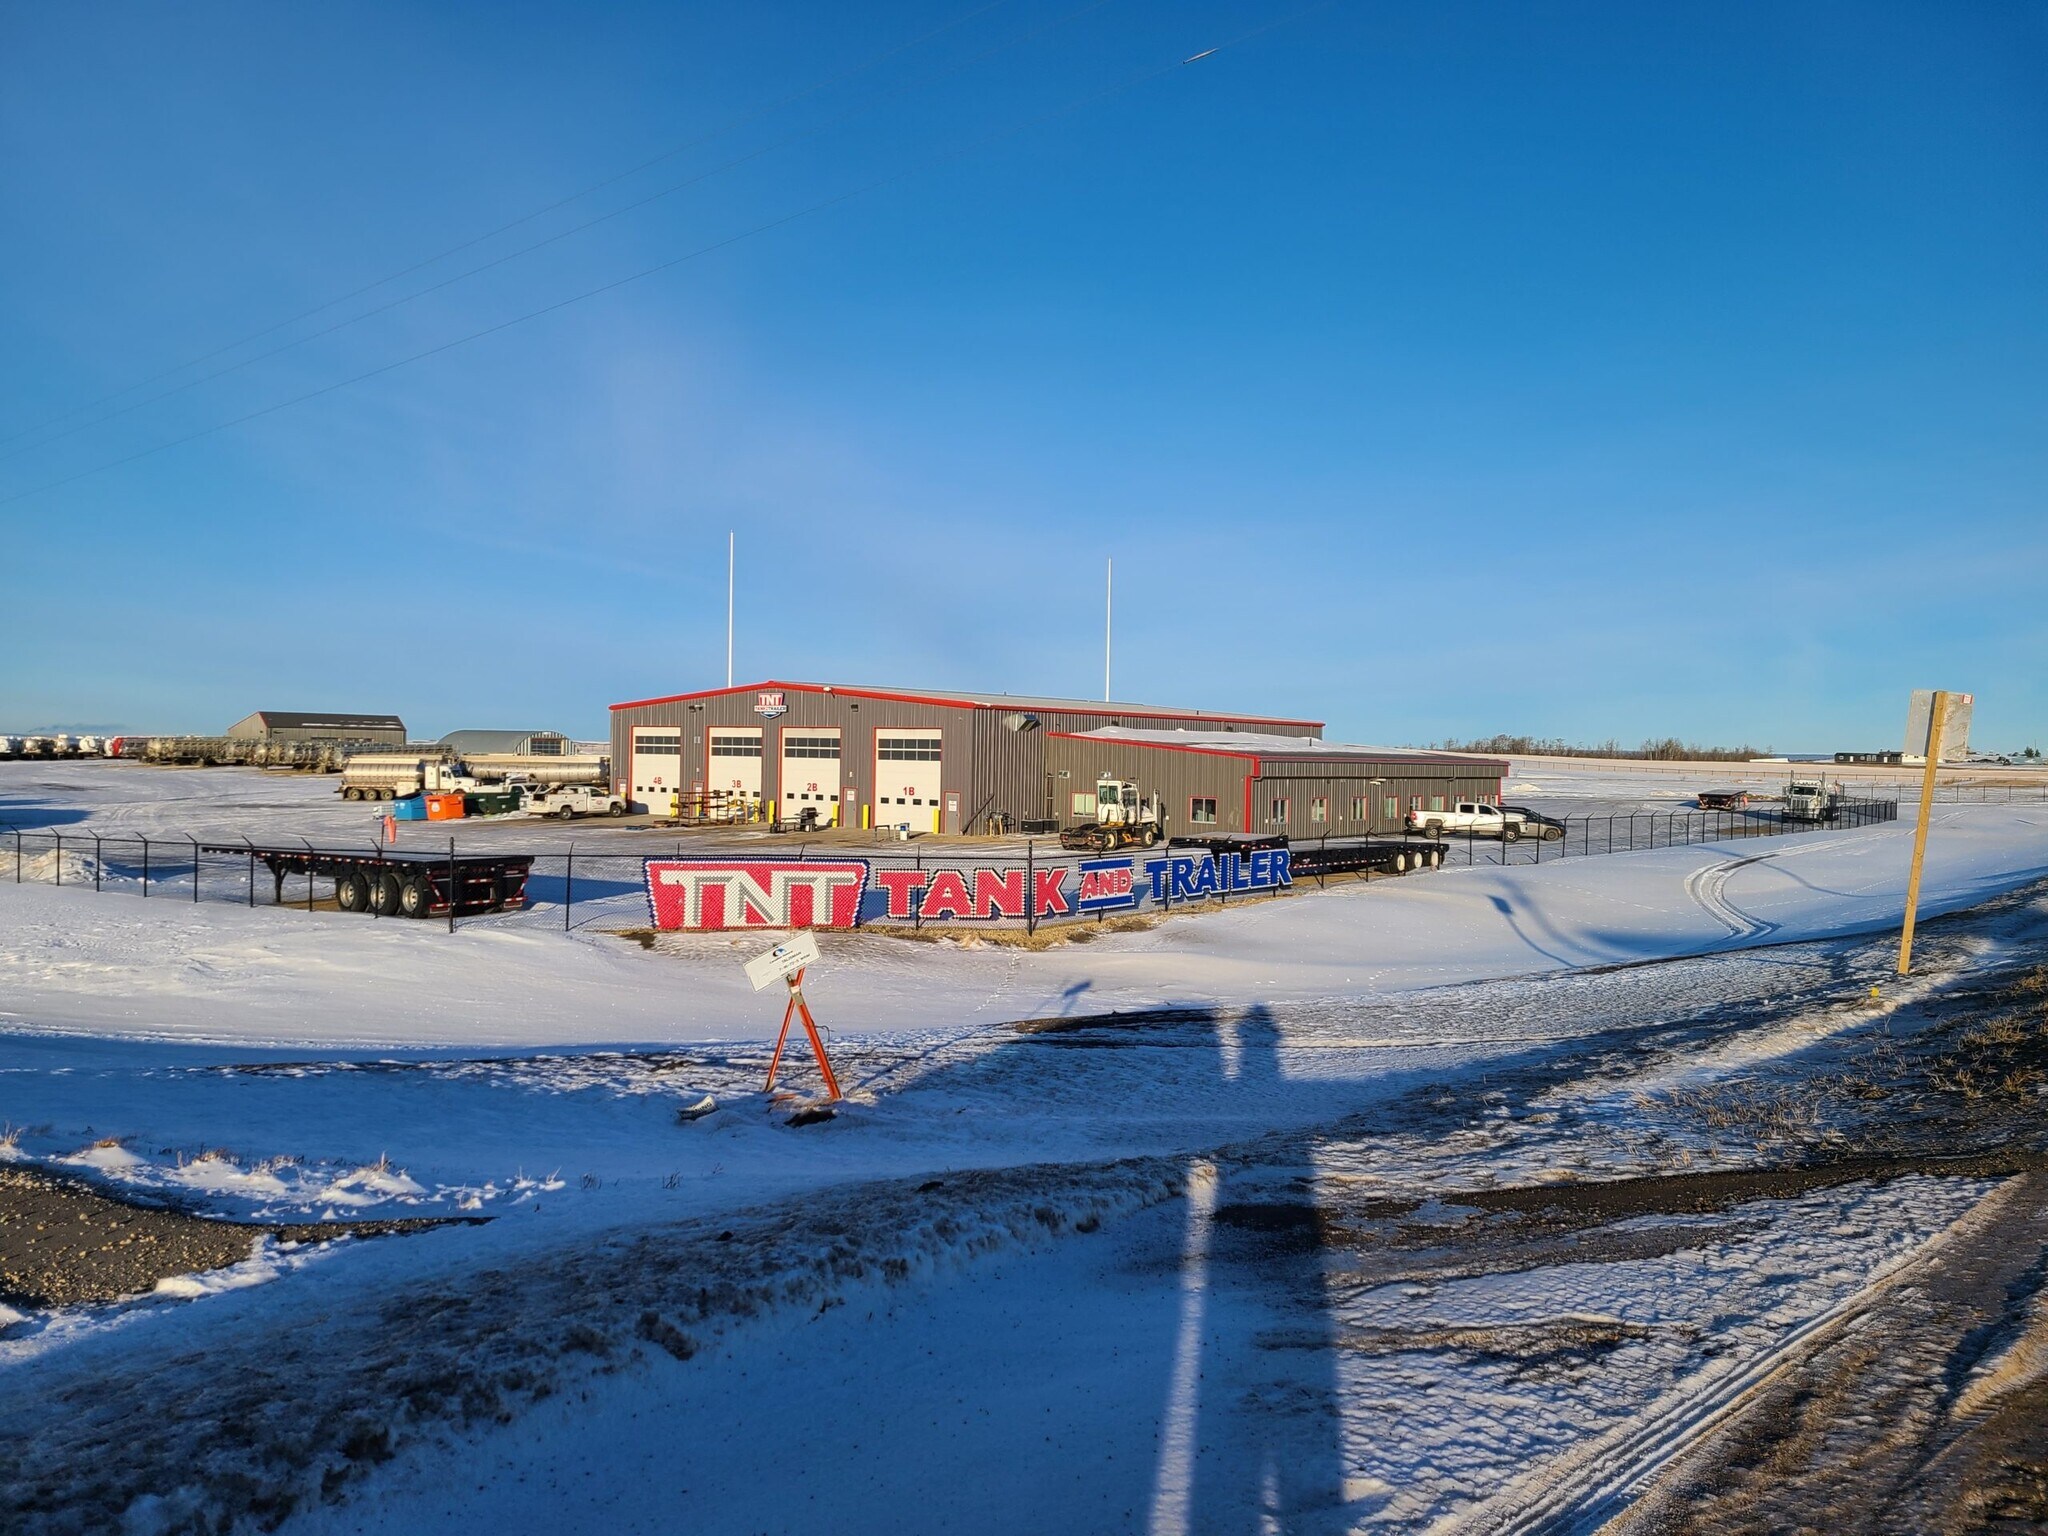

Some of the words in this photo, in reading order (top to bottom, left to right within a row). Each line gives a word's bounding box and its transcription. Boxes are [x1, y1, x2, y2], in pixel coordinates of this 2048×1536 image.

[759, 694, 782, 705] TNT
[653, 776, 663, 785] 4B
[731, 780, 742, 788] 3B
[806, 783, 818, 792] 2B
[902, 787, 915, 796] 1B
[659, 869, 859, 927] TNT
[875, 866, 1070, 918] TANK
[1080, 868, 1134, 900] AND
[1144, 848, 1294, 902] TRAILER
